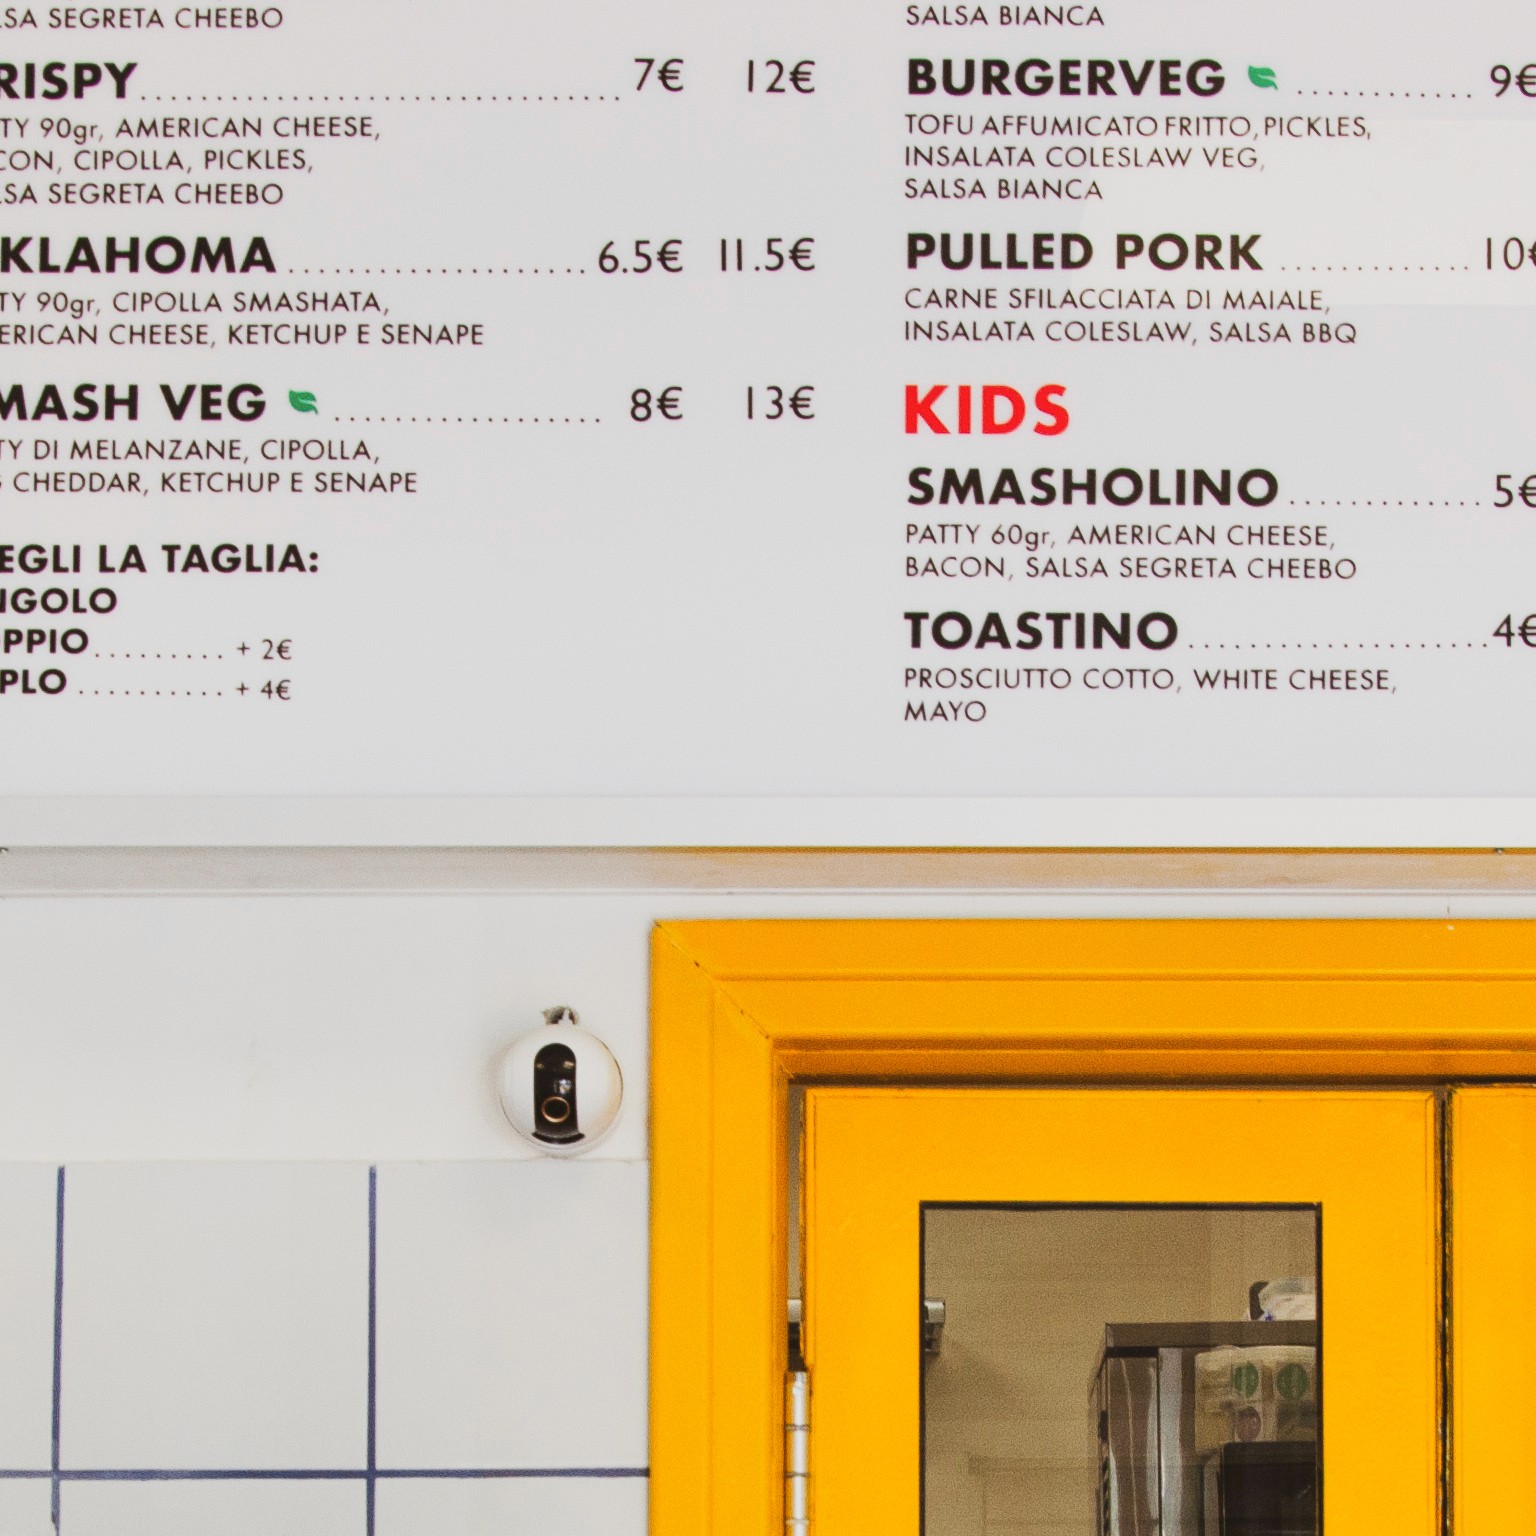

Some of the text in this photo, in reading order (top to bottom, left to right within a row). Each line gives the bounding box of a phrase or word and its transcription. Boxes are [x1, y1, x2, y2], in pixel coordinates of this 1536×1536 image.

[48, 7, 165, 30] SEGRETA
[174, 7, 284, 29] CHEEBO
[906, 4, 1105, 27] SALSA BIANCA
[634, 57, 684, 93] 7€
[747, 59, 816, 95] 12€
[907, 58, 1226, 98] BURGERVEG
[39, 117, 105, 146] 90gr,
[115, 116, 262, 139] AMERICAN
[272, 115, 380, 140] CHEESE,
[904, 113, 1371, 141] TOFU AFFUMICATO FRITTO, PICKLES,
[73, 149, 192, 174] CIPOLLA,
[204, 148, 312, 172] PICKLES,
[904, 145, 1265, 171] INSALATA COLESLAW VEG,
[48, 182, 165, 205] SEGRETA
[174, 182, 284, 206] CHEEBO
[904, 177, 1103, 201] SALSA BIANCA
[598, 238, 683, 275] 6.5€
[906, 232, 1094, 271] PULLED
[1116, 232, 1263, 272] PORK
[36, 291, 102, 320] 90gr,
[112, 291, 223, 313] CIPOLLA
[233, 291, 390, 315] SMASHATA,
[904, 287, 1329, 314] CARNE SFILACCIATA DI MAIALE,
[108, 323, 215, 349] CHEESE,
[228, 323, 347, 346] KETCHUP
[381, 323, 483, 346] SENAPE
[904, 319, 1357, 345] INSALATA COLESLAW, SALSA BBQ
[159, 383, 267, 423] VEG
[629, 385, 683, 423] 8€
[747, 385, 815, 421] 13€
[904, 383, 1070, 437] KIDS
[33, 439, 59, 461] DI
[69, 439, 248, 464] MELANZANE,
[260, 438, 379, 464] CIPOLLA,
[12, 471, 148, 496] CHEDDAR,
[161, 471, 281, 494] KETCHUP
[314, 471, 417, 494] SENAPE
[907, 466, 1279, 508] SMASHOLINO
[905, 523, 1334, 553] PATTY 60gr, AMERICAN CHEESE,
[98, 544, 147, 574] LA
[161, 543, 319, 574] TAGLIA:
[905, 555, 1357, 581] BACON, SALSA SEGRETA CHEEBO
[903, 610, 1179, 651] TOASTINO
[904, 667, 1396, 694] PROSCIUTTO COTTO, WHITE CHEESE,
[904, 700, 987, 723] MAYO
